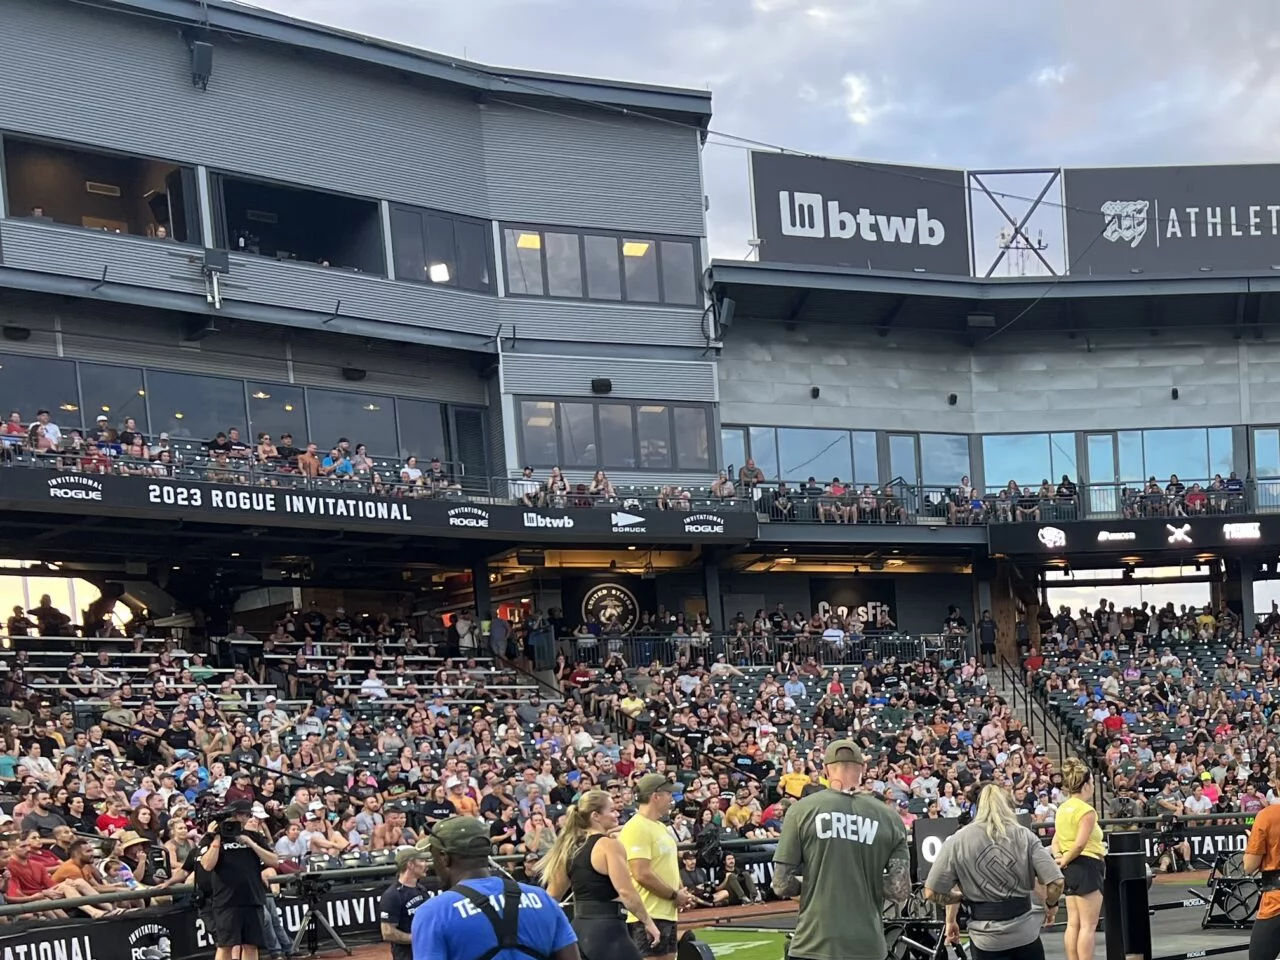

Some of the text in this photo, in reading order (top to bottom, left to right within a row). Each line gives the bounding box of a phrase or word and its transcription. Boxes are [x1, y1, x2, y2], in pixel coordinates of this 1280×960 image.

[828, 200, 945, 247] btwb
[48, 476, 102, 490] INVITATIONAL
[50, 488, 102, 500] ROGUE
[149, 485, 411, 522] 2023 ROGUE INVITATIONAL
[448, 507, 489, 518] INVITATIONAL
[683, 513, 724, 524] INVITATIONAL
[450, 517, 489, 528] ROGUE
[537, 514, 574, 529] btwb
[685, 525, 724, 533] ROGUE
[815, 812, 879, 845] CREW
